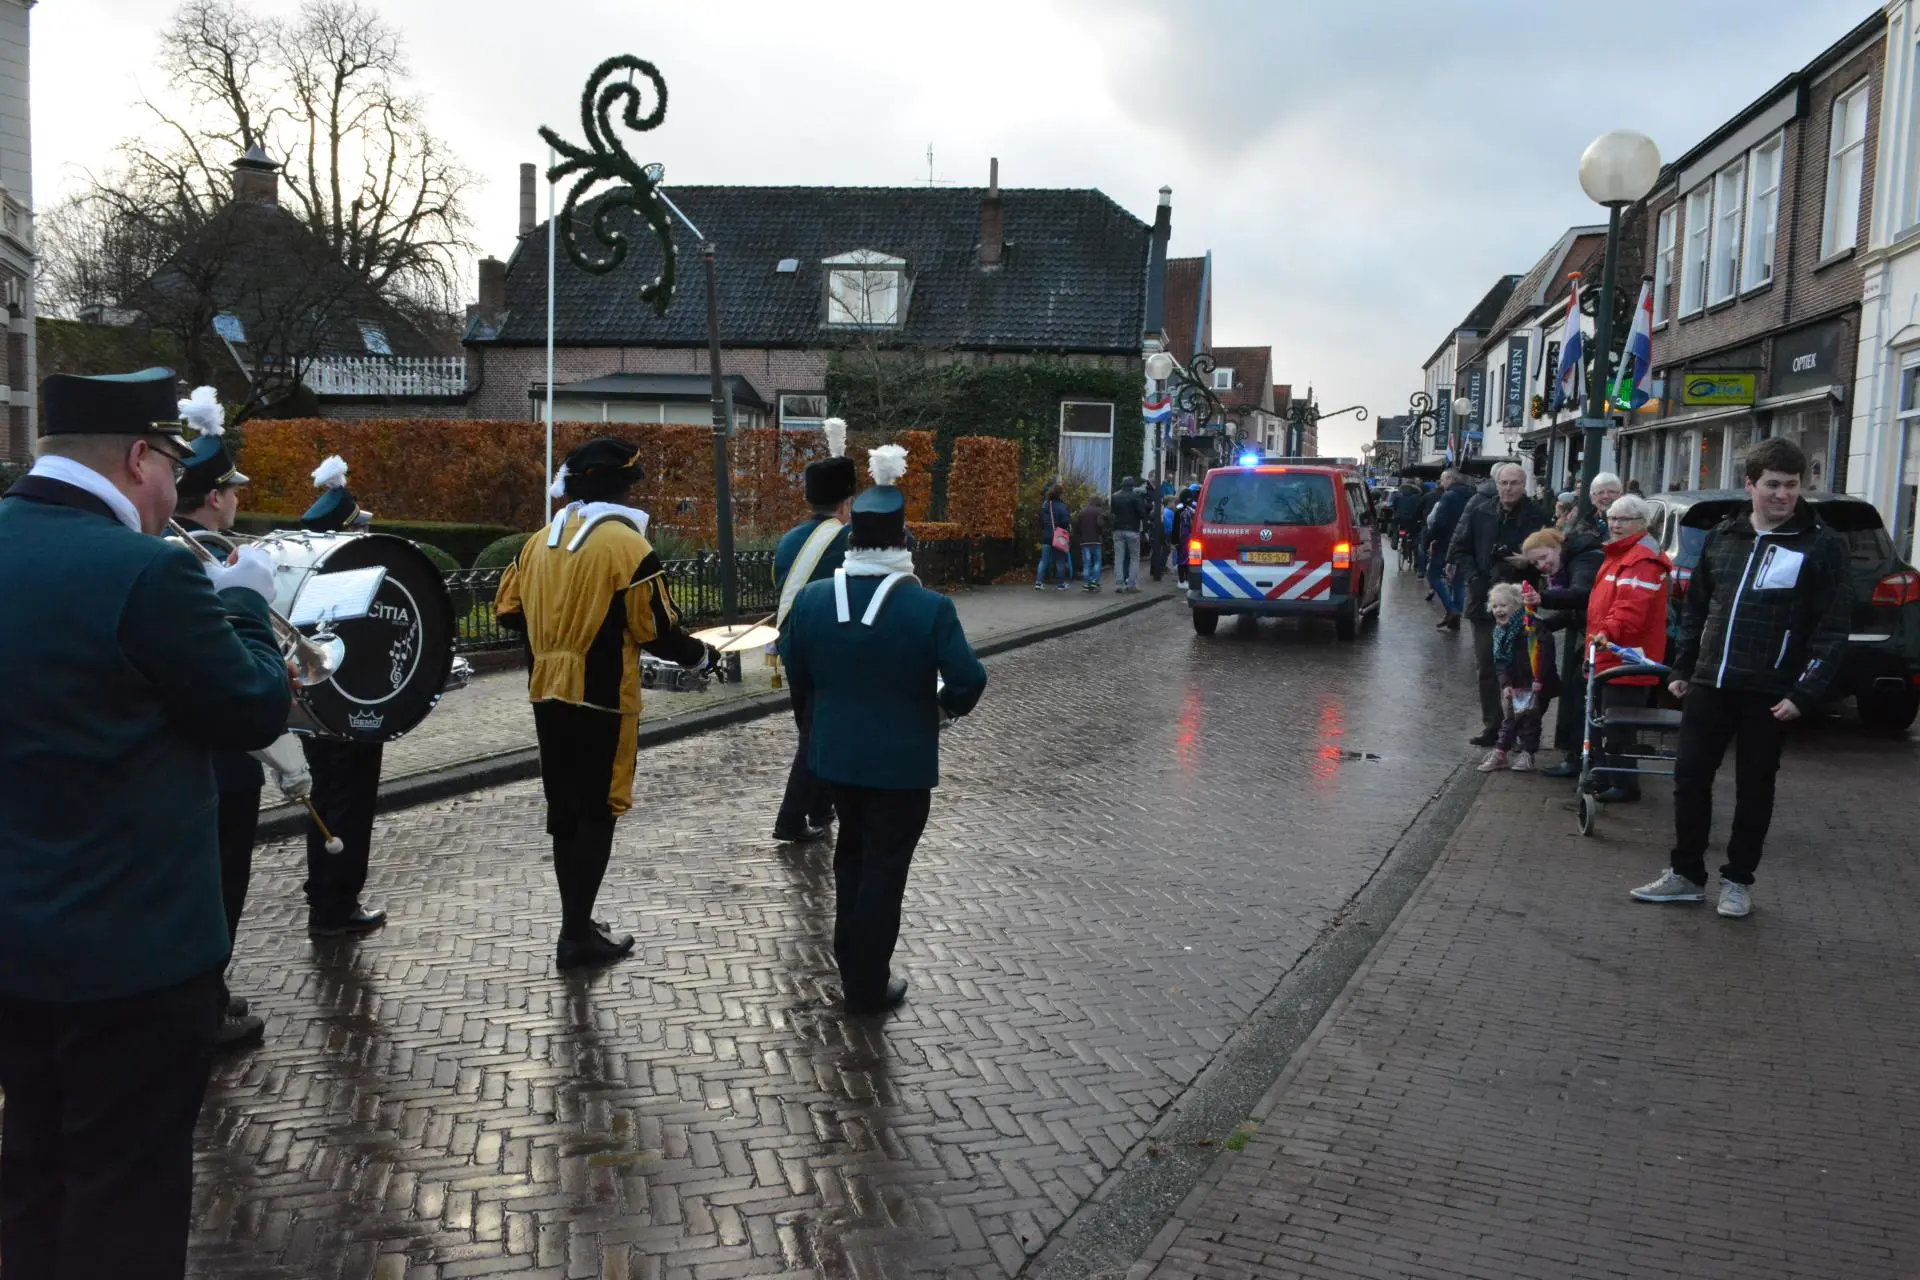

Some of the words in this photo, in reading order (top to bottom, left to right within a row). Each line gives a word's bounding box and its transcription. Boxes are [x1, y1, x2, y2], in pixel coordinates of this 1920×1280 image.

[1509, 348, 1523, 401] SLAPEN
[1792, 353, 1817, 373] OPTIEK
[1469, 372, 1481, 420] TEXTIEL
[1202, 527, 1250, 535] BRANDWEER
